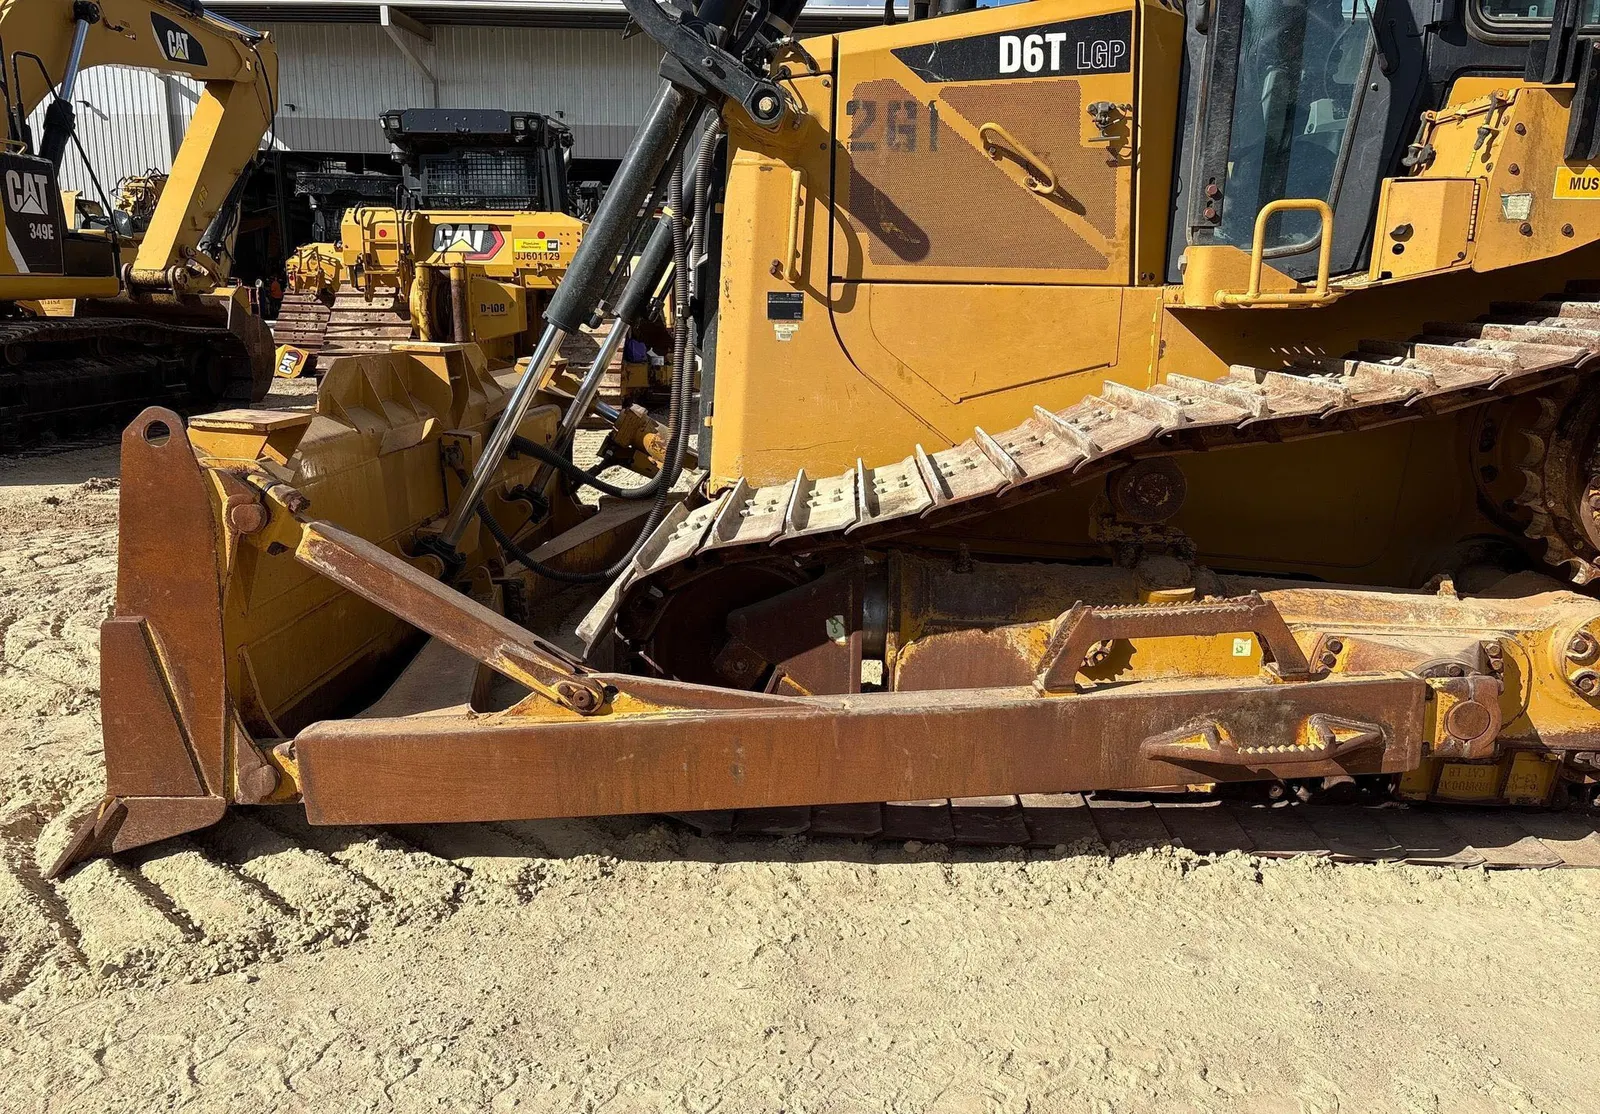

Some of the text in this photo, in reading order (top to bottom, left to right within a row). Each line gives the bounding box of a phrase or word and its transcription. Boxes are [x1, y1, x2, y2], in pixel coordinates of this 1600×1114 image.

[167, 29, 189, 60] CAT
[999, 32, 1126, 74] D6T LGP
[5, 169, 48, 215] CAT
[29, 222, 54, 240] 349E
[433, 224, 488, 252] CAT
[515, 252, 560, 260] JJ601129
[278, 352, 298, 374] CAT
